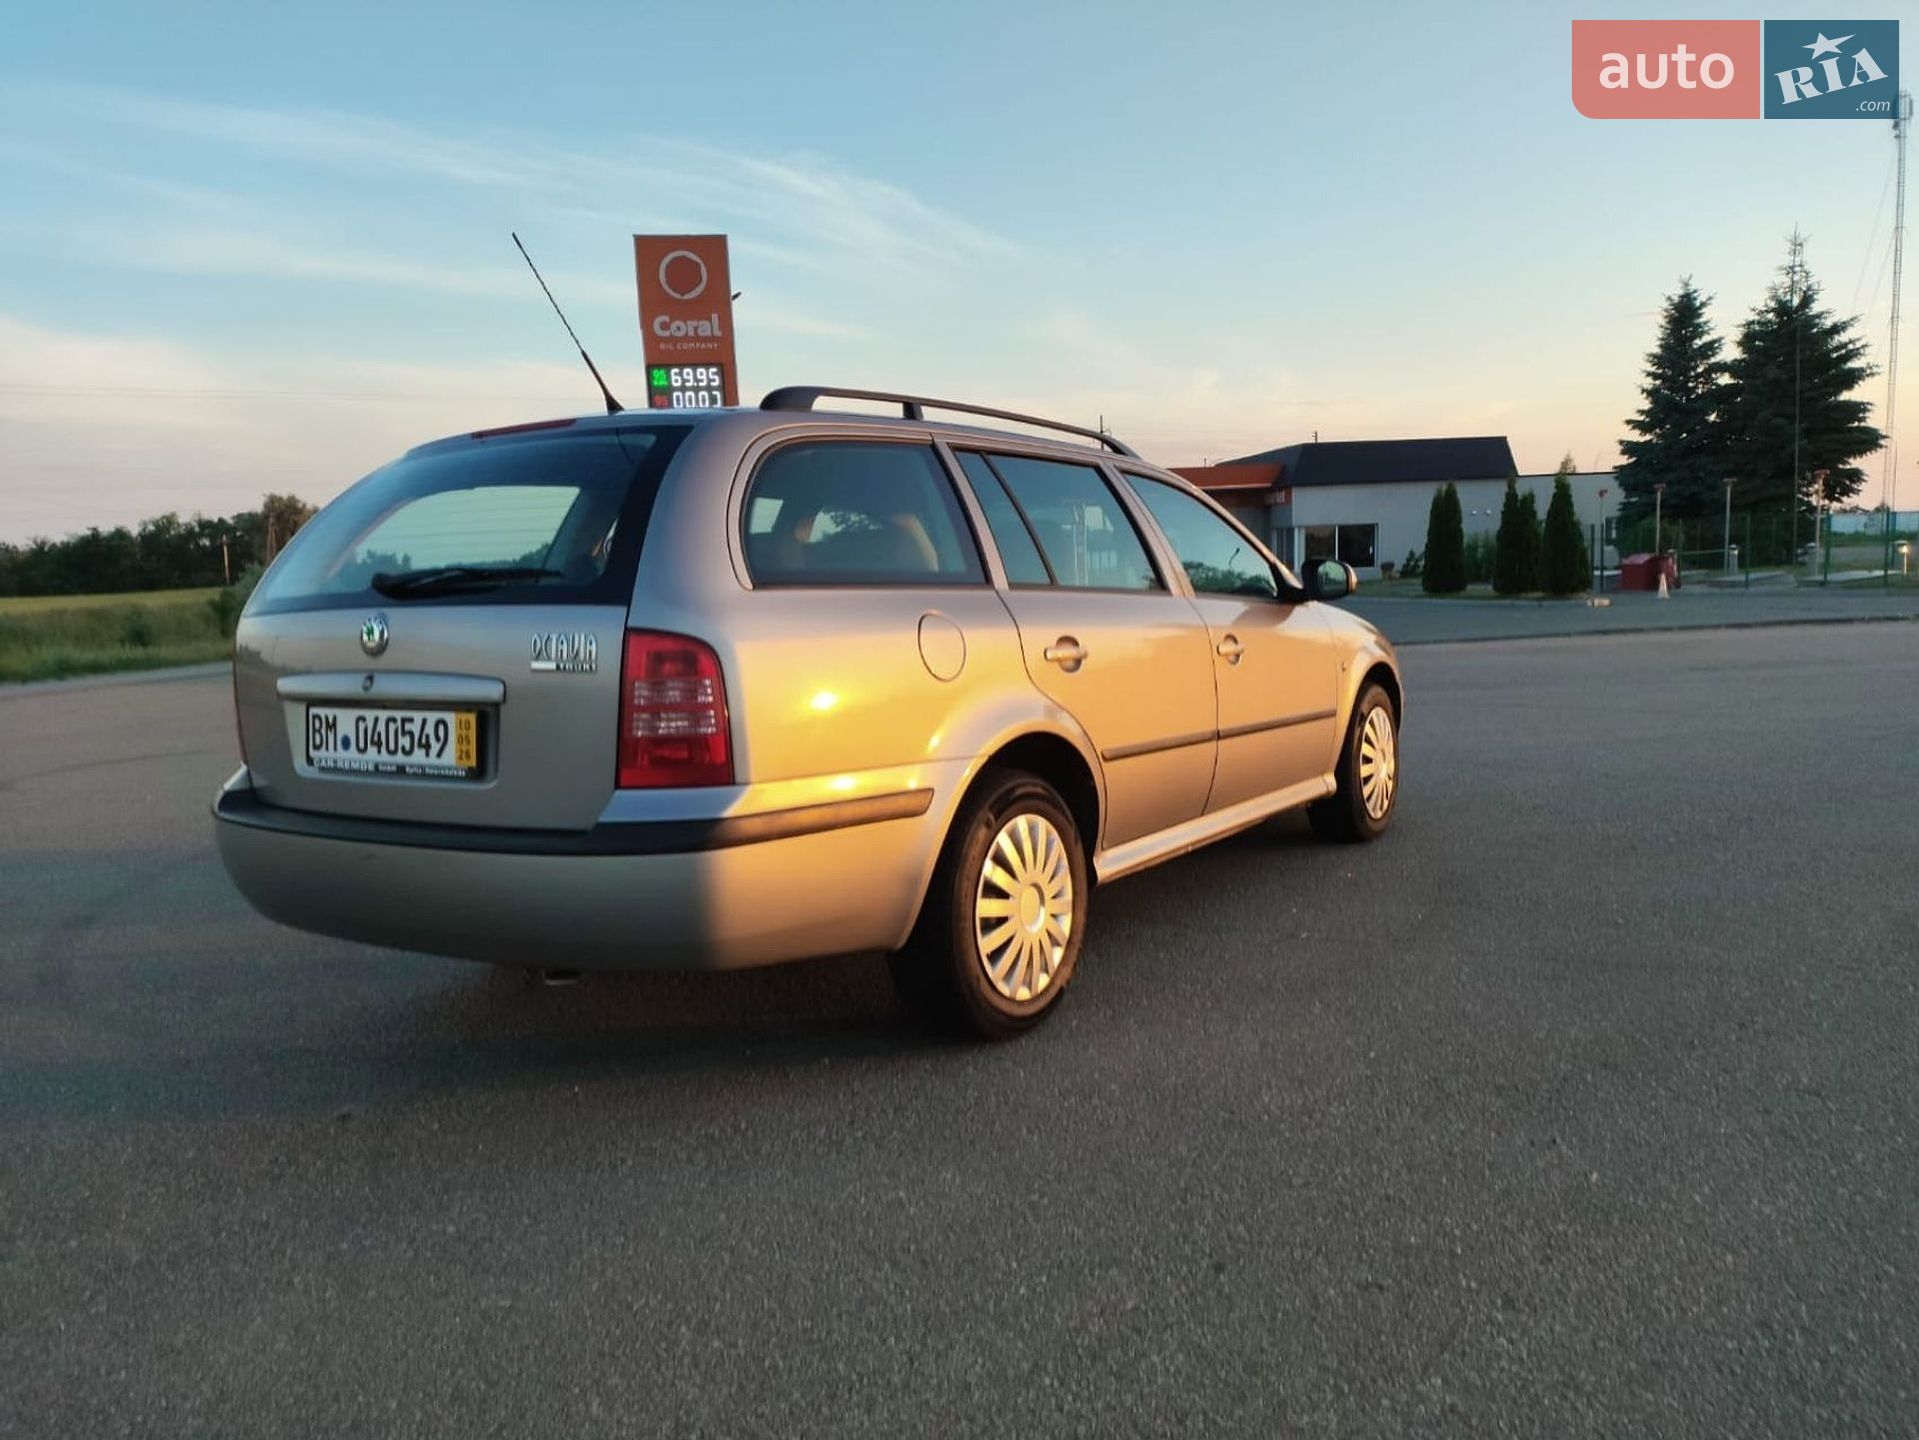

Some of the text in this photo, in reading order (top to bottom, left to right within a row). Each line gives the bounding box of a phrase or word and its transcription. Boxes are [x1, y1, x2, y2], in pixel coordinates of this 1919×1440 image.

[653, 313, 722, 338] Coral
[676, 342, 719, 351] COMPANY
[670, 367, 720, 387] 69.95
[531, 632, 598, 661] OCTAVIA
[311, 713, 450, 759] BM 040549
